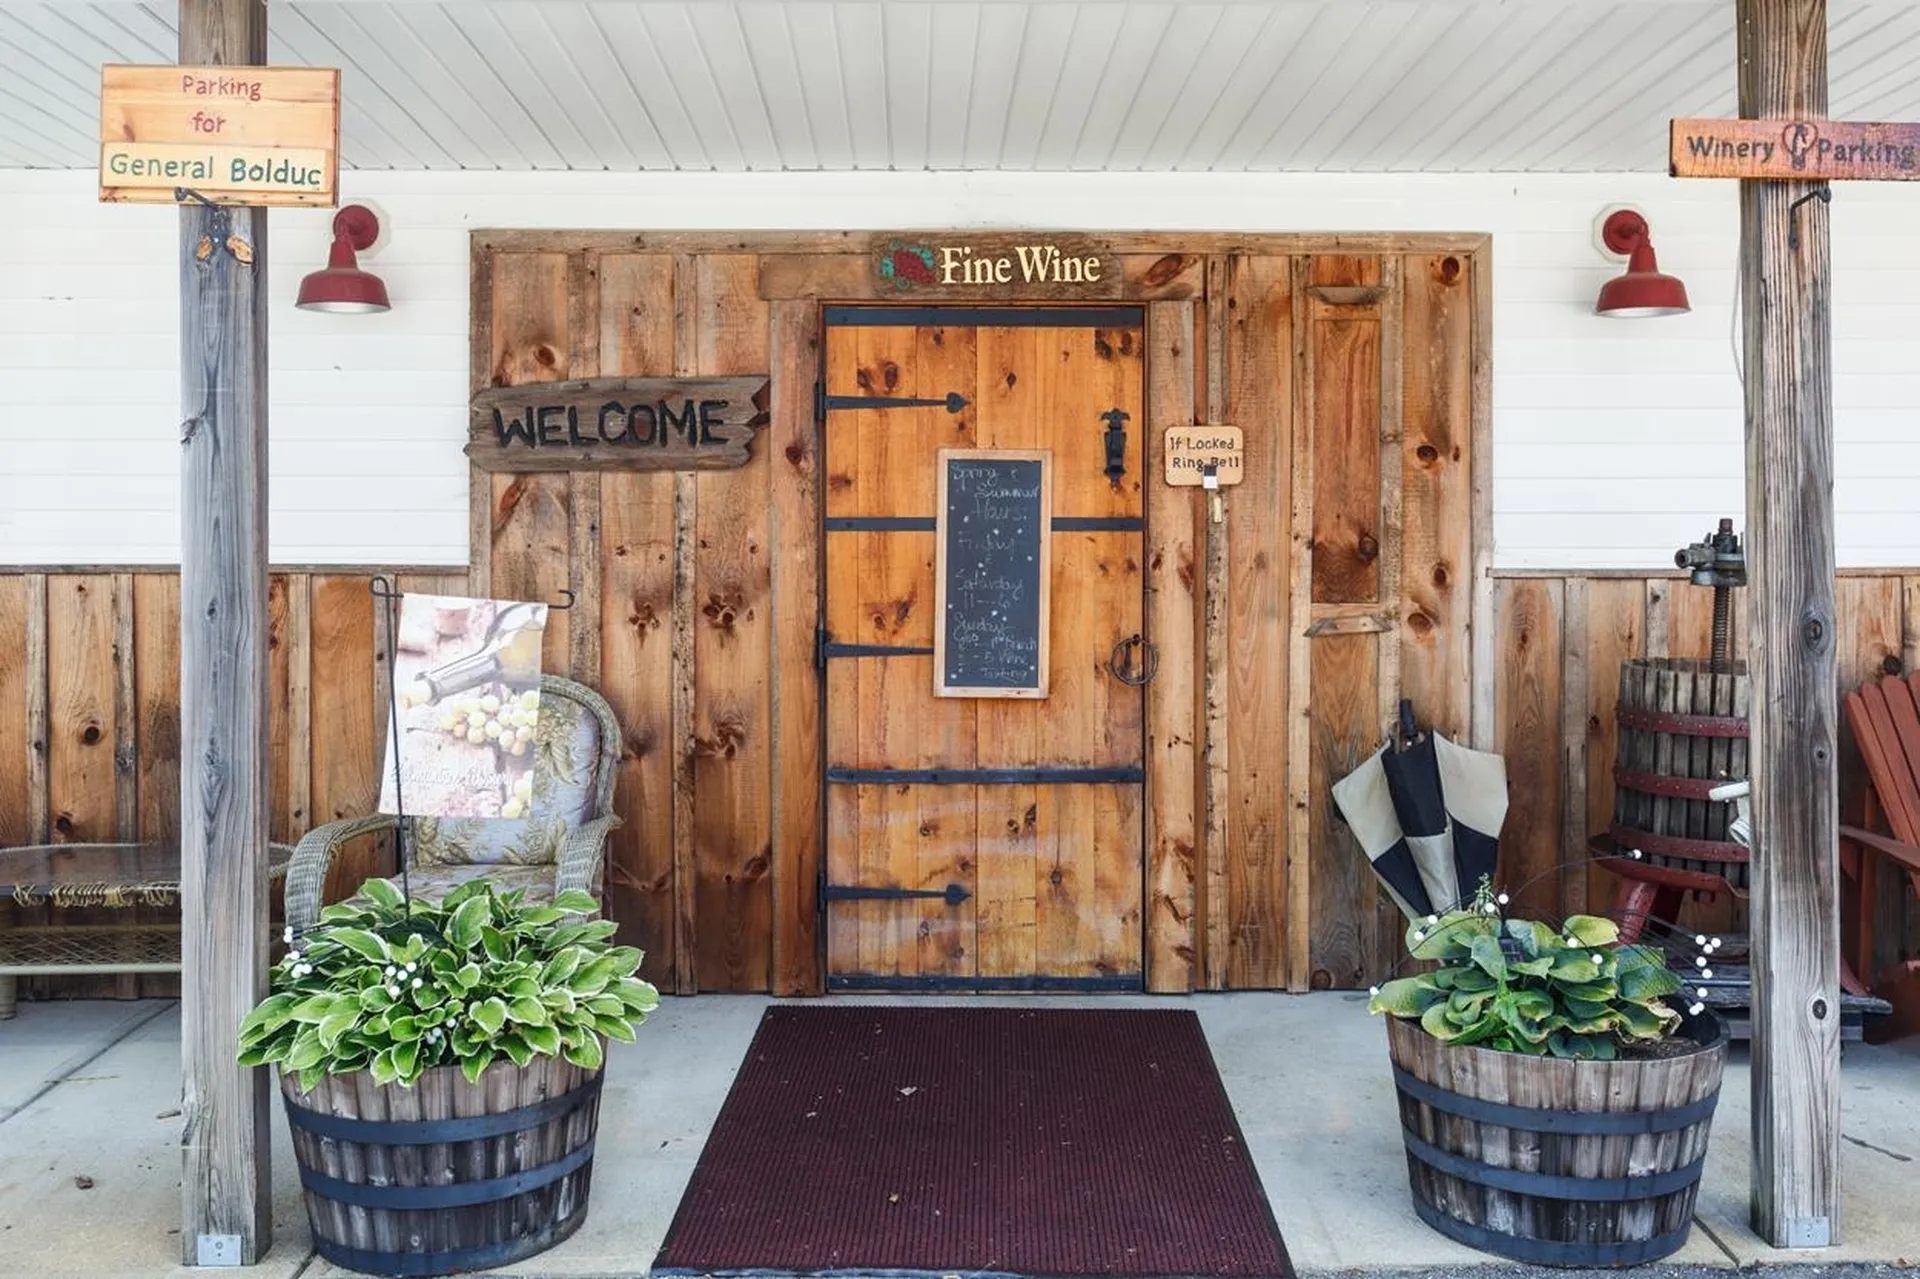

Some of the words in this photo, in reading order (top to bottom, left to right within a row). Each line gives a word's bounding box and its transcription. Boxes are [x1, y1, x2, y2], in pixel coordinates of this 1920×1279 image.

[182, 75, 262, 101] Parking
[192, 112, 226, 133] for
[1687, 136, 1775, 164] Winery
[1817, 138, 1917, 170] Parking
[110, 153, 213, 179] General
[230, 158, 322, 185] Bolduc
[940, 246, 1012, 284] Fine
[1015, 246, 1101, 283] Wine
[492, 399, 730, 449] WELCOME
[1187, 437, 1234, 450] Locked
[1172, 457, 1204, 473] Ring
[1210, 456, 1239, 468] Bell
